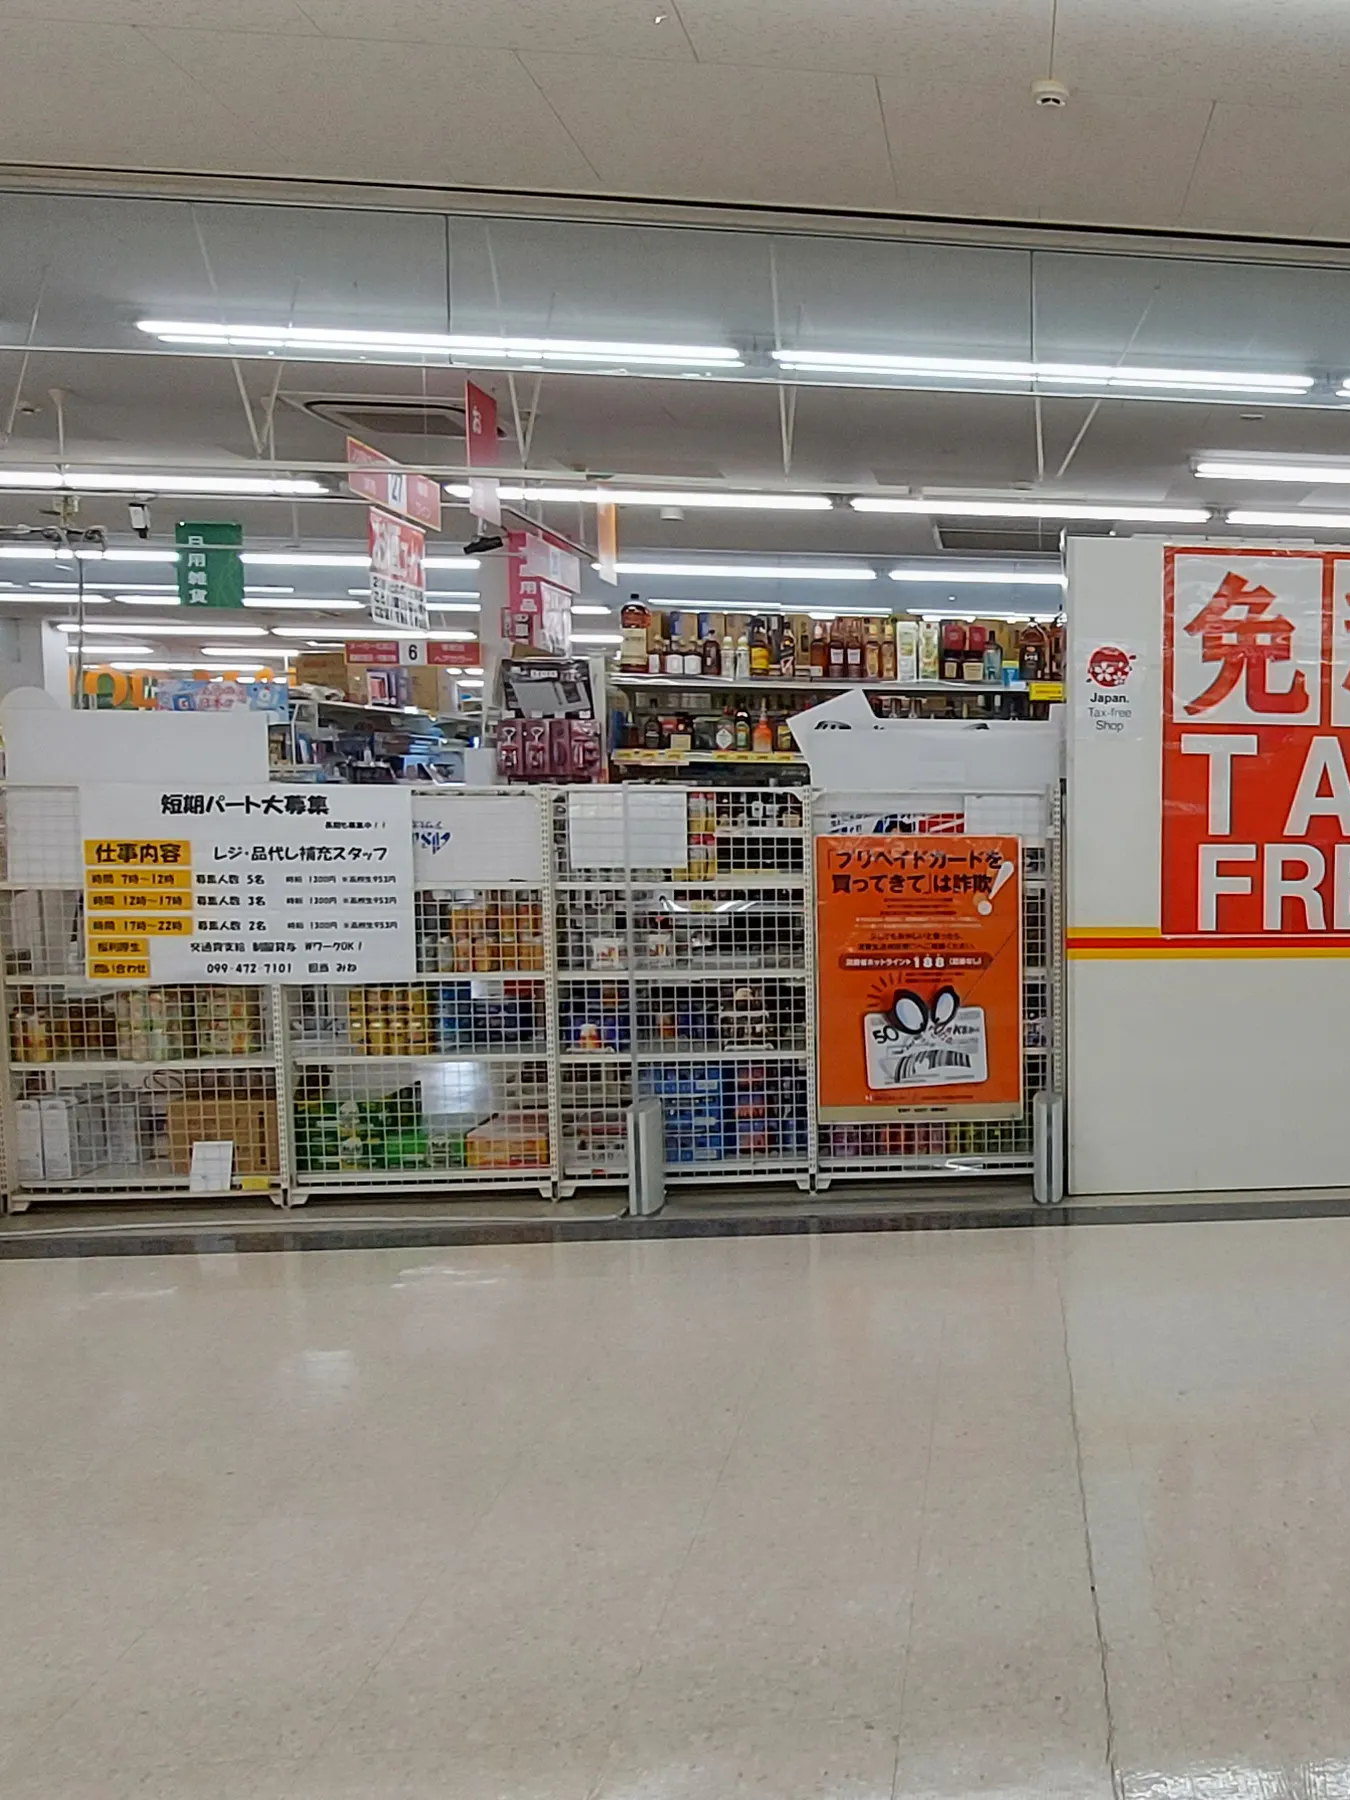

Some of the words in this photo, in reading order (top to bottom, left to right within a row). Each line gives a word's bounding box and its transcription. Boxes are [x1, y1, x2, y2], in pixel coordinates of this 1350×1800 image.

[188, 535, 208, 604] 日用雑貨
[408, 644, 418, 661] 6
[1090, 692, 1130, 704] Japan.
[1088, 707, 1132, 717] Tax-free
[1096, 720, 1124, 733] Shop
[161, 793, 330, 815] 短期パート大募集
[95, 843, 182, 864] 仕事内容
[247, 875, 265, 885] 5名
[248, 896, 265, 906] 3名
[249, 921, 266, 931] 2名
[913, 956, 945, 968] 188
